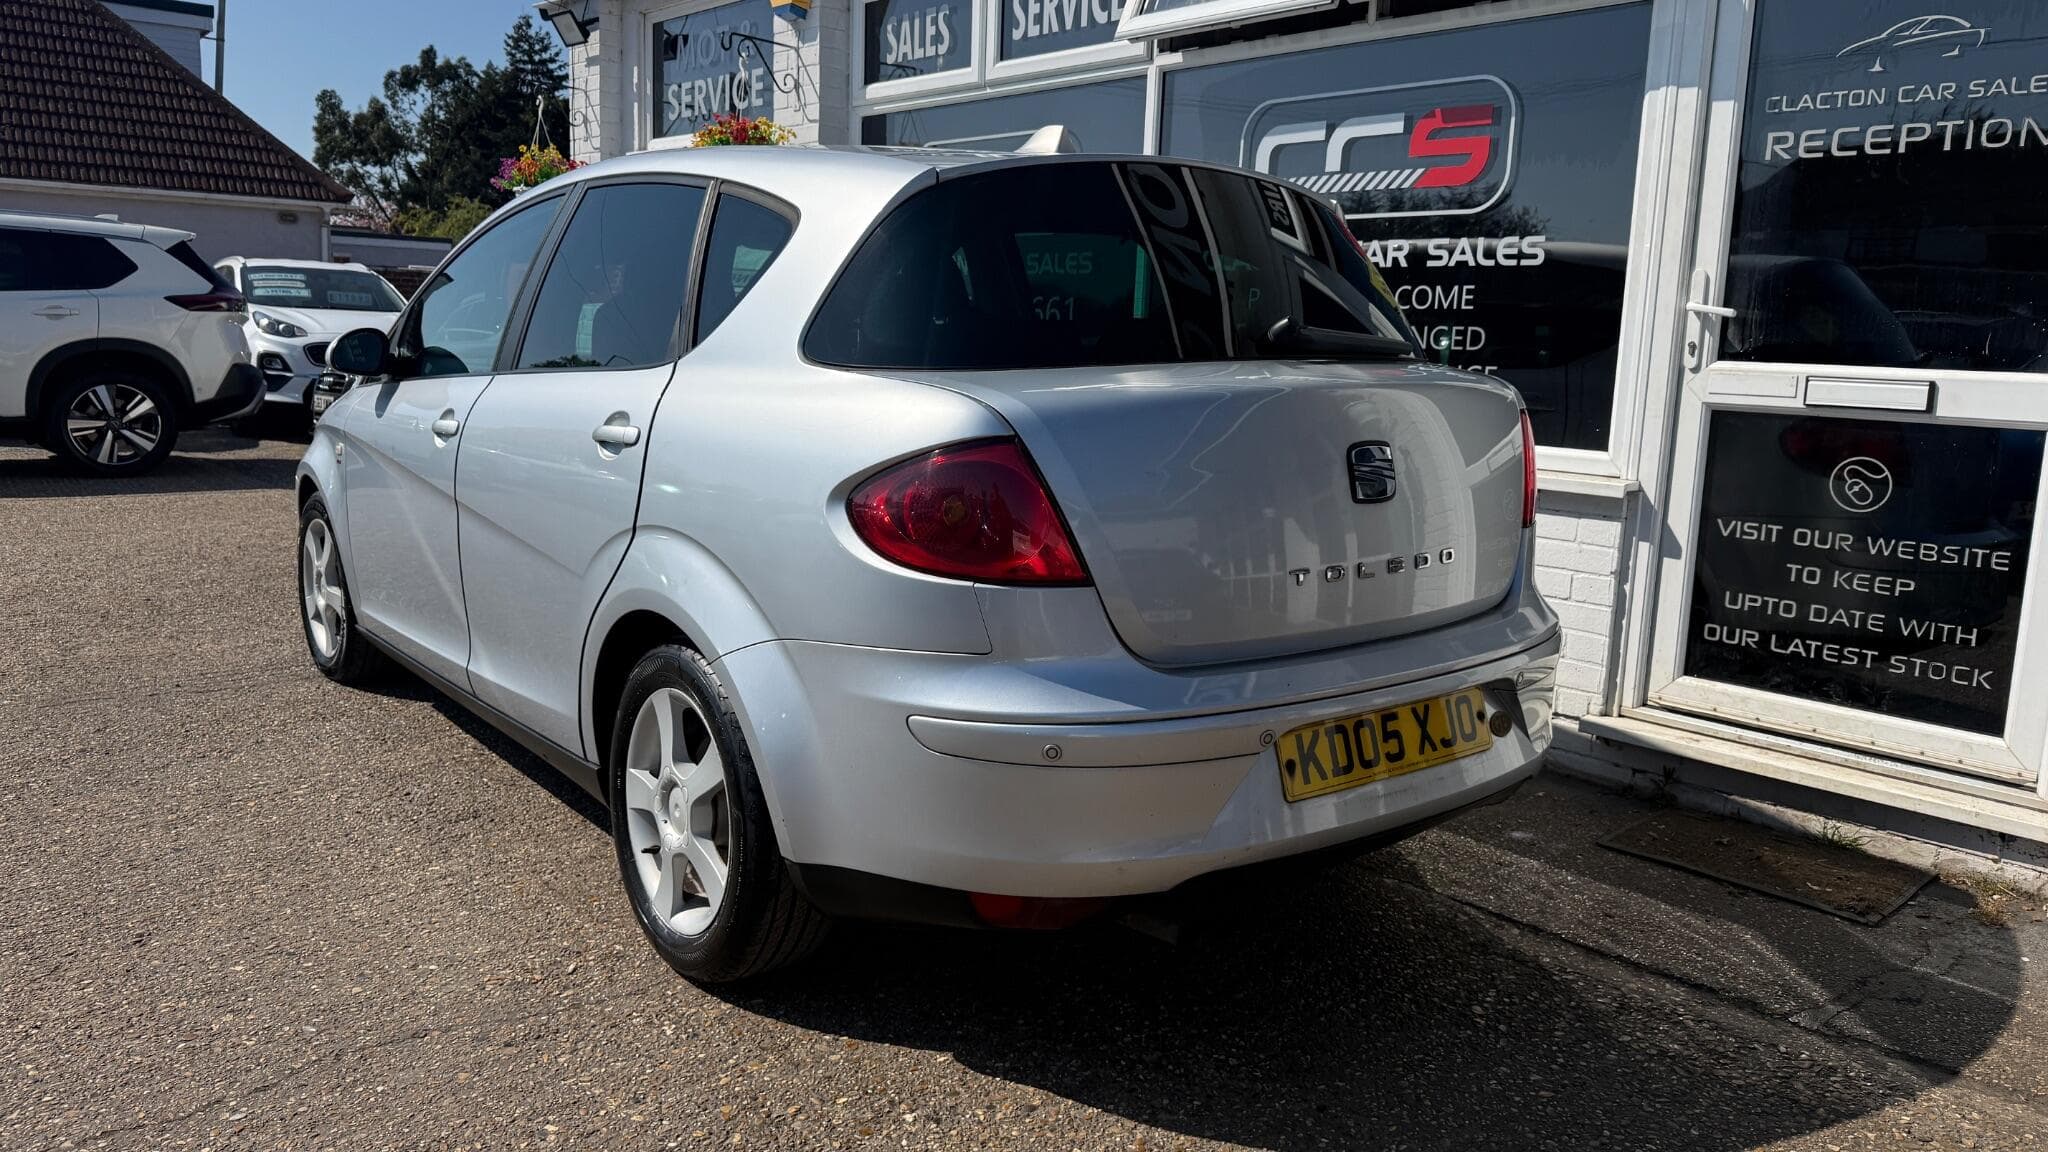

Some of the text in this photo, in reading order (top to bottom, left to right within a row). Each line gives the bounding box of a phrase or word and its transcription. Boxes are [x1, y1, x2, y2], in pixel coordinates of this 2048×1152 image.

[886, 3, 951, 65] SALES
[667, 67, 764, 121] SERVICE
[1765, 74, 2048, 113] CLACTON CAR SALE
[1765, 116, 2048, 161] RECEPTION
[1361, 235, 1546, 268] AR SALES
[1394, 285, 1476, 310] COME
[1289, 547, 1455, 587] TOLEDO
[1717, 518, 2012, 571] VISIT OUR WEBSITE
[1787, 563, 1916, 597] TO KEEP
[1725, 590, 1978, 648] UPTO DATE WITH
[1703, 623, 1994, 690] OUR LATEST STOCK
